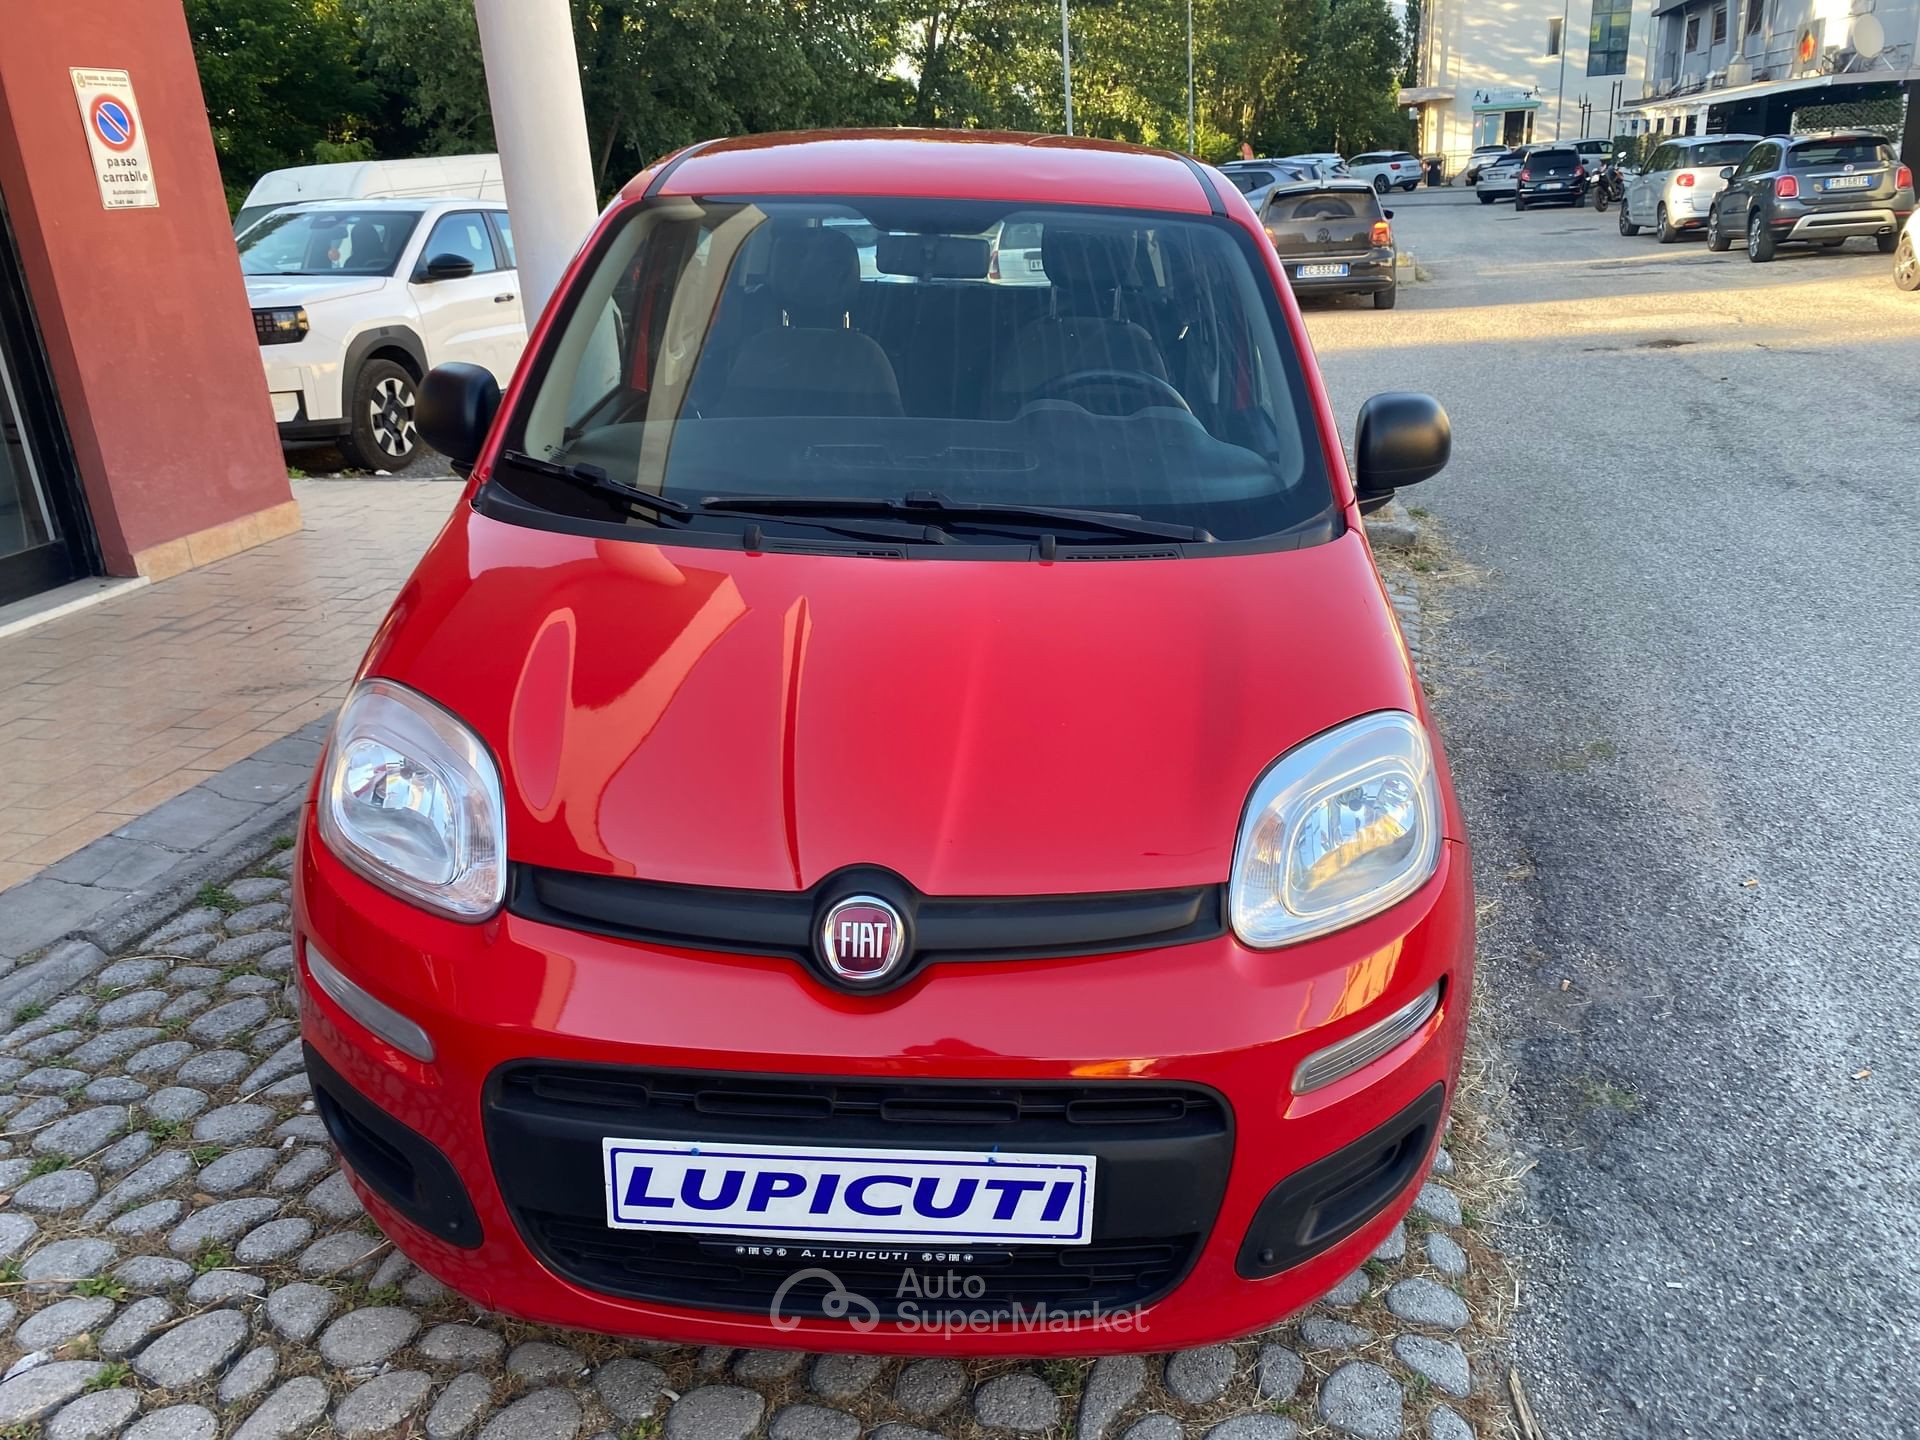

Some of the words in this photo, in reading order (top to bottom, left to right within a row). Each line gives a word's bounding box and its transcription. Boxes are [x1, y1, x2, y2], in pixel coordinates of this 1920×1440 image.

[107, 158, 138, 168] passo
[103, 170, 148, 183] carrabile
[1304, 266, 1313, 275] EC
[840, 921, 887, 959] FIAT
[623, 1165, 1075, 1223] LUPICUTI
[801, 1249, 816, 1258] A.
[822, 1250, 908, 1261] LUPICUTI
